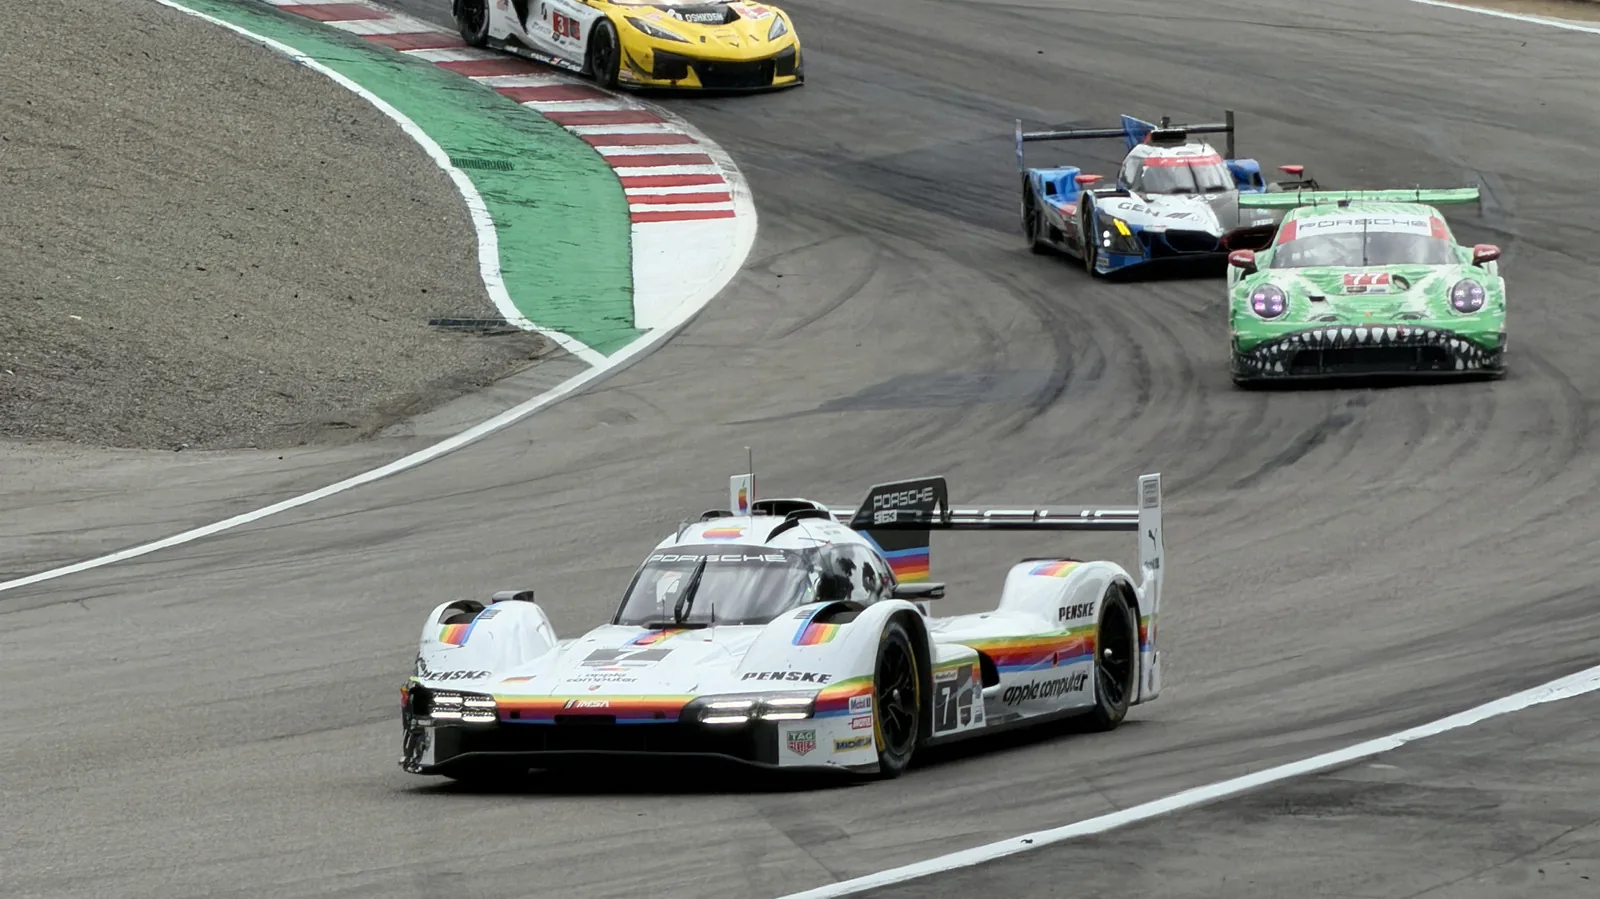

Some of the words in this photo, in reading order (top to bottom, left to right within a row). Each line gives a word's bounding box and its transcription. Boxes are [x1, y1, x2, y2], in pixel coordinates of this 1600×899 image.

[557, 16, 564, 33] 3
[1117, 202, 1160, 217] GEN
[1299, 218, 1428, 230] PORSCHE
[1349, 272, 1383, 285] 77
[873, 486, 933, 510] PORSCHE
[874, 509, 897, 525] 963
[648, 554, 787, 563] PORSCHE
[1058, 601, 1095, 622] PENSKE
[613, 648, 648, 661] 7
[740, 671, 832, 684] PENSKE
[1003, 679, 1040, 706] apple
[1040, 671, 1088, 699] computer
[941, 686, 950, 725] 7
[790, 732, 813, 740] TAG
